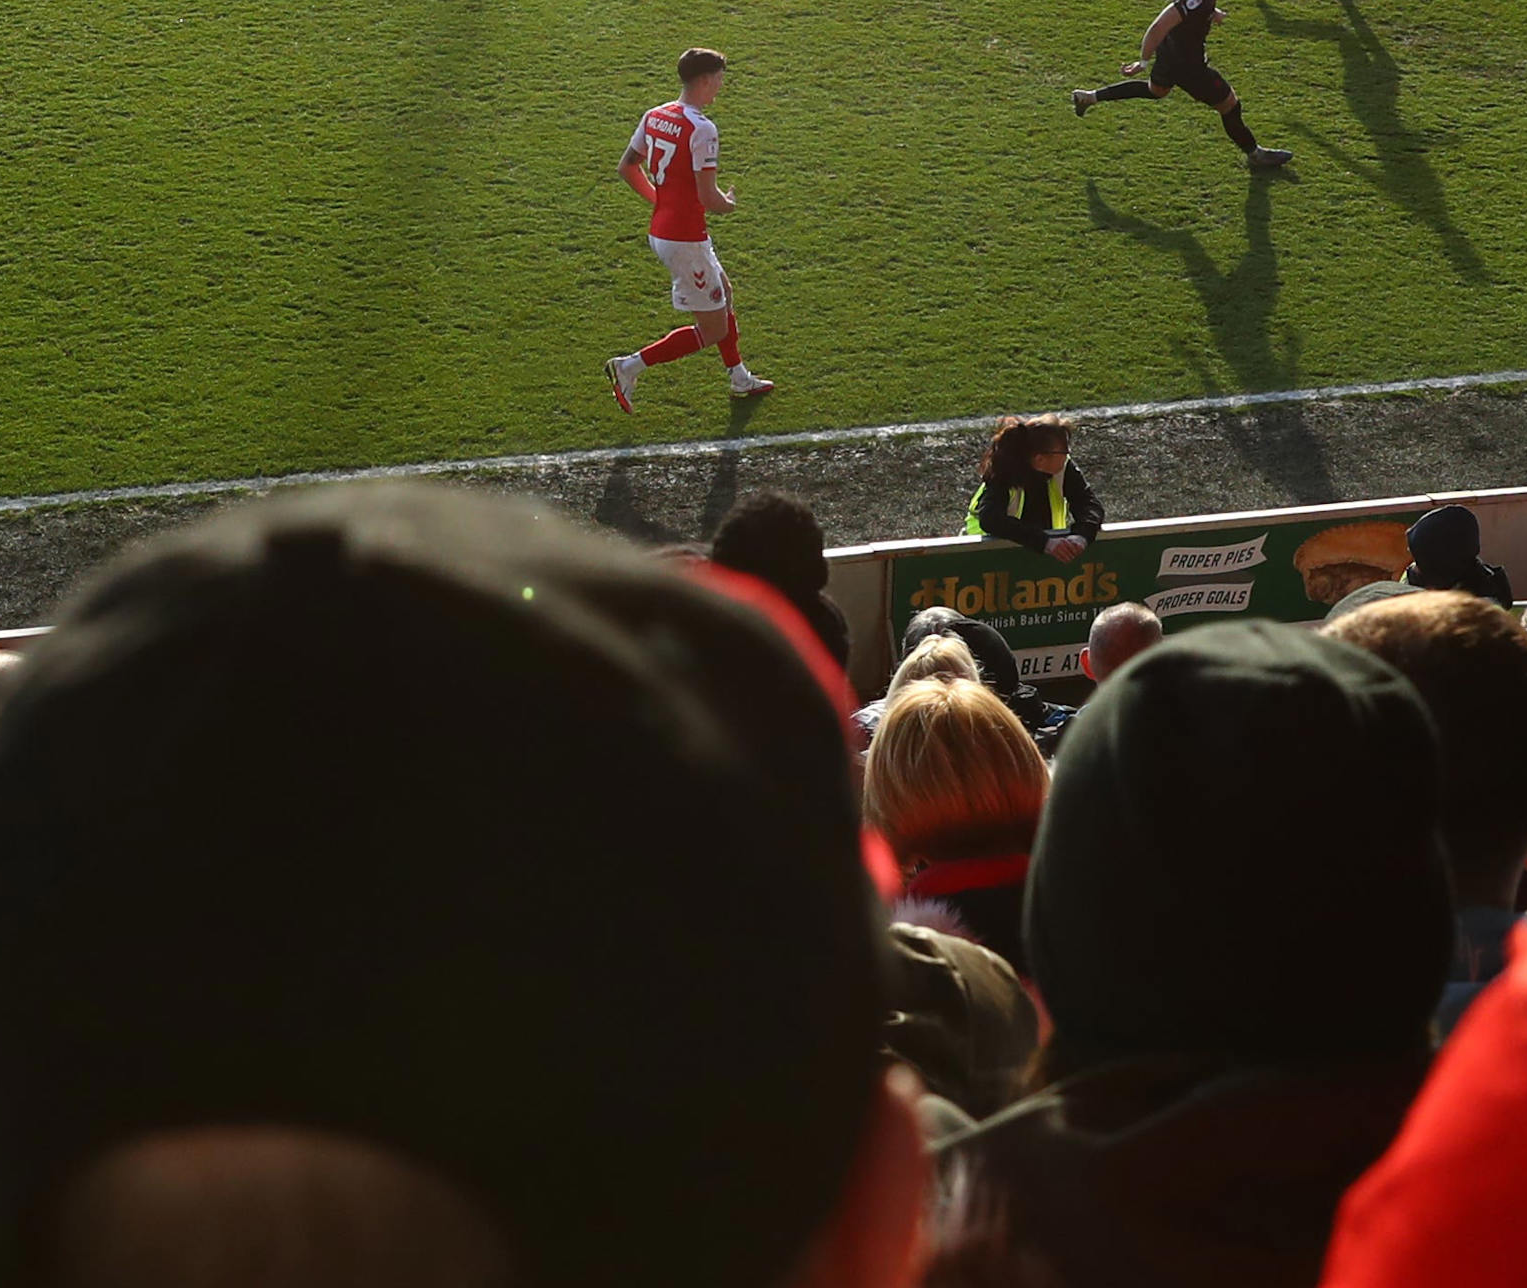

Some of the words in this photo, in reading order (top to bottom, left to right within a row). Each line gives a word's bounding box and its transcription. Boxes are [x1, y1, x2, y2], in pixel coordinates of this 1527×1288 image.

[1169, 553, 1222, 568] PROPER
[1224, 546, 1255, 565] PIES
[910, 562, 1119, 615] Holland's
[1155, 591, 1204, 612] PROPER
[1206, 590, 1247, 605] GOALS
[1020, 613, 1052, 626] Baker
[1057, 608, 1087, 623] Since
